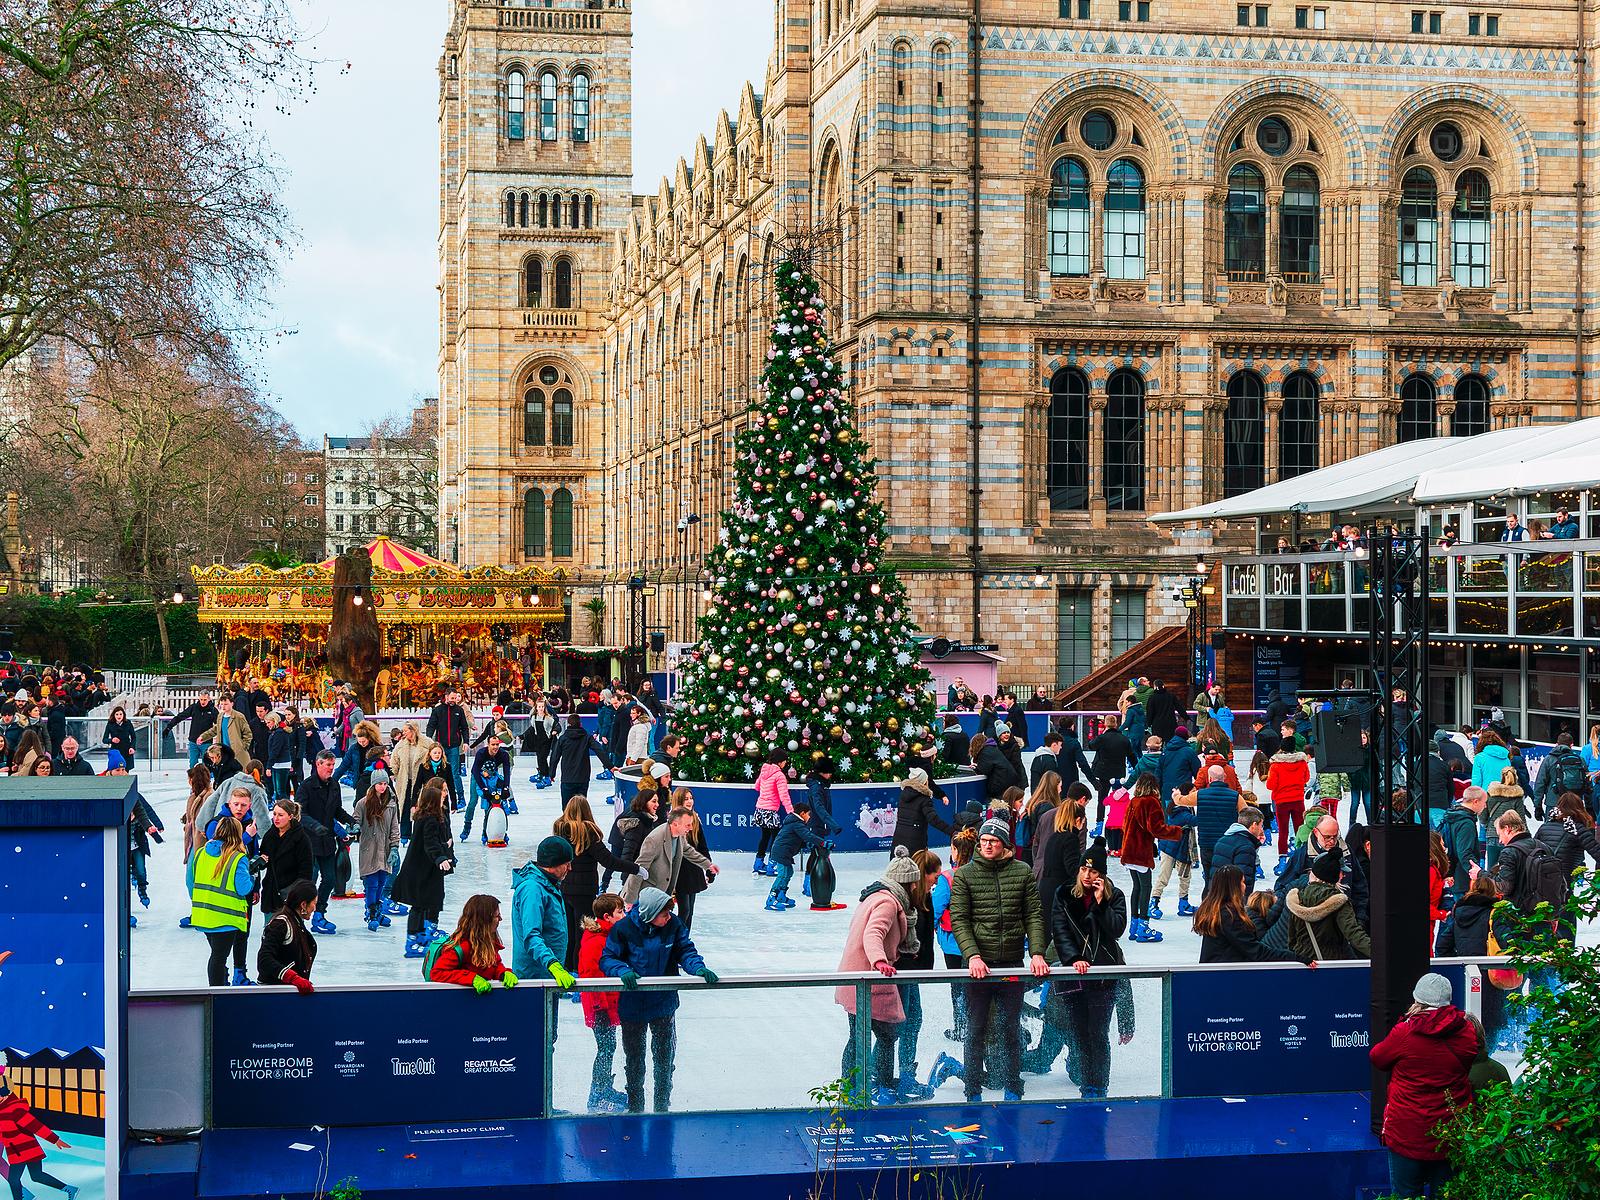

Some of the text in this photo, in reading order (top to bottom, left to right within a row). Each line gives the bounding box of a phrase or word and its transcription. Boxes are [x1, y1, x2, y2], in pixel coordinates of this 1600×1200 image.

[1232, 564, 1294, 595] Café Bar
[706, 813, 732, 827] ICE
[1187, 1030, 1262, 1042] FLOWERBOMB
[230, 1057, 314, 1069] FLOWERBOMB
[464, 1060, 499, 1068] REGATTA
[811, 1136, 855, 1145] ICE
